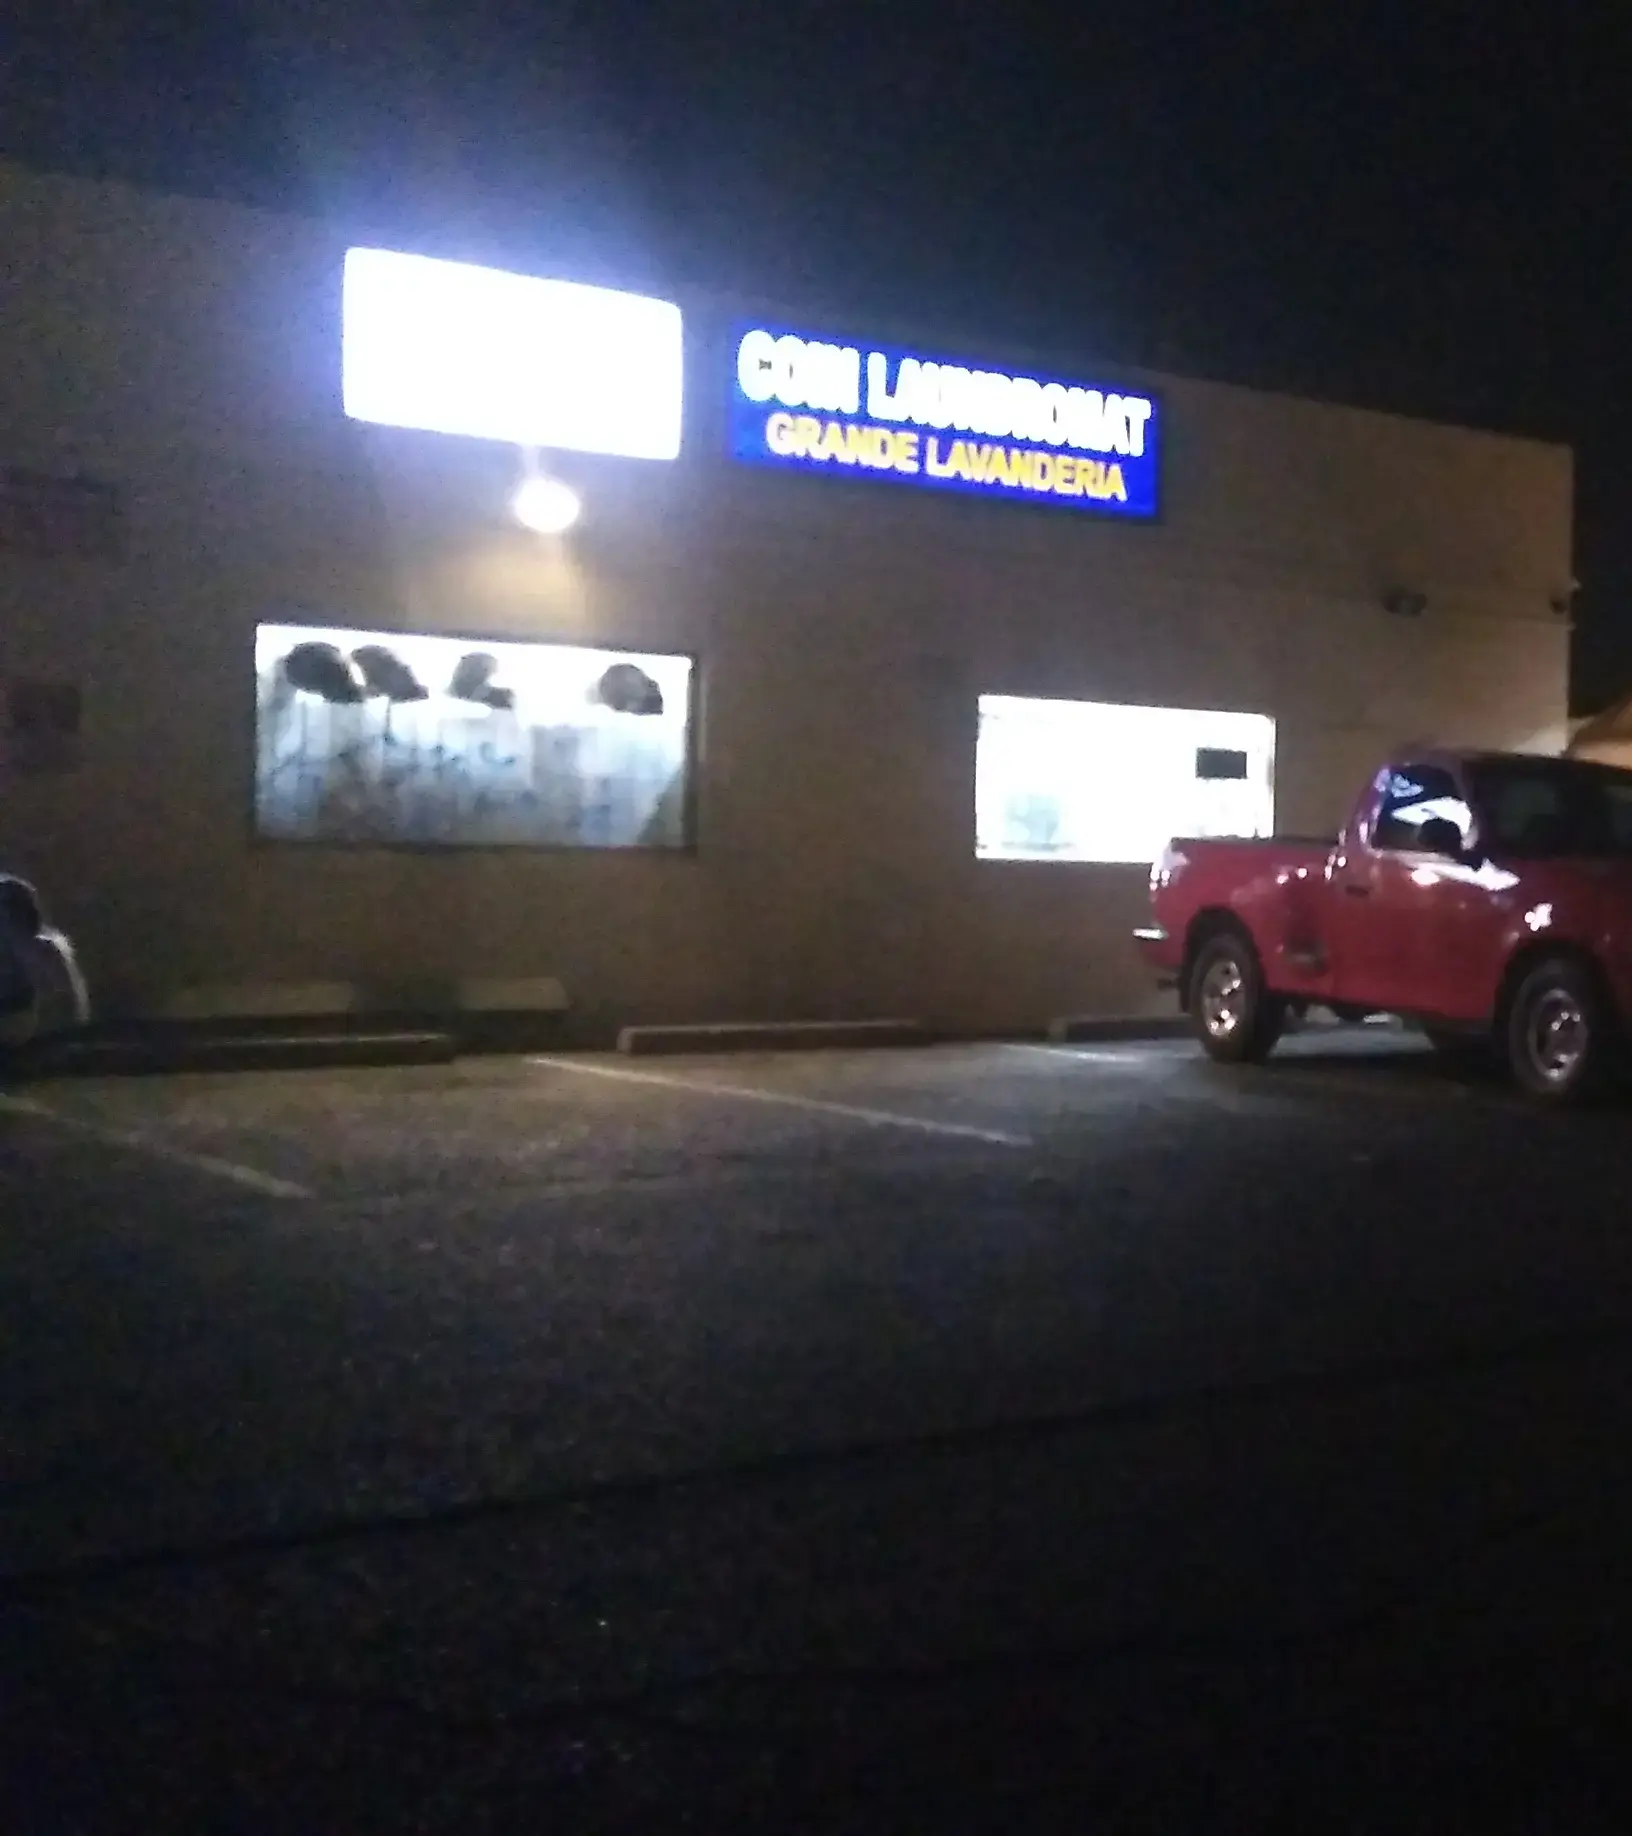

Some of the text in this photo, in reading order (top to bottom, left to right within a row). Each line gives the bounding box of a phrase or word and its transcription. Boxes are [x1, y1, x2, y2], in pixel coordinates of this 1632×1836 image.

[738, 330, 1152, 457] COIN LAUNDROMAT
[765, 412, 1128, 502] GRANDE LAVANDERIA
